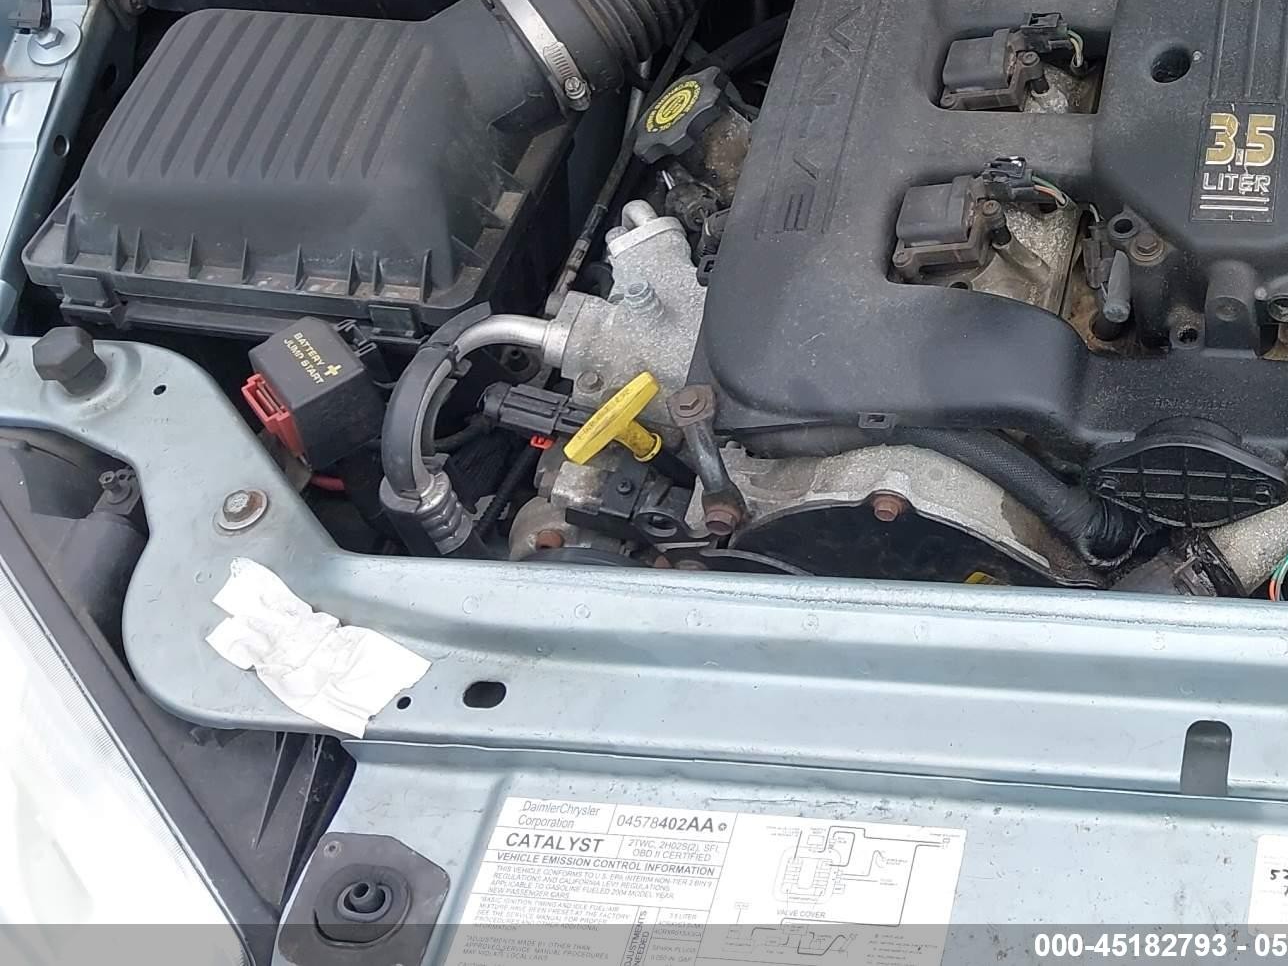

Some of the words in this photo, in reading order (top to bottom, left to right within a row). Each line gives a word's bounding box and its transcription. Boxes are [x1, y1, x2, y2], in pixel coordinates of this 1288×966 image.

[1205, 113, 1276, 167] 3.5
[1202, 172, 1271, 195] LITER
[293, 332, 326, 367] BATTERY
[300, 359, 325, 385] START
[522, 800, 600, 817] DaimlerChrysler
[517, 814, 575, 830] Corporation
[616, 814, 715, 833] 04578402AA
[505, 832, 605, 853] CATALYST
[496, 852, 539, 864] VEHICLE
[541, 855, 591, 868] EMISSION
[592, 859, 642, 871] CONTROL
[644, 863, 716, 876] INFORMATION
[632, 848, 653, 858] OBD
[662, 851, 712, 862] CERTIFIED
[494, 872, 542, 883] REGULATIONS
[559, 877, 601, 887] CALIFORNIA
[545, 882, 582, 893] GASOLINE
[801, 910, 827, 919] COVER
